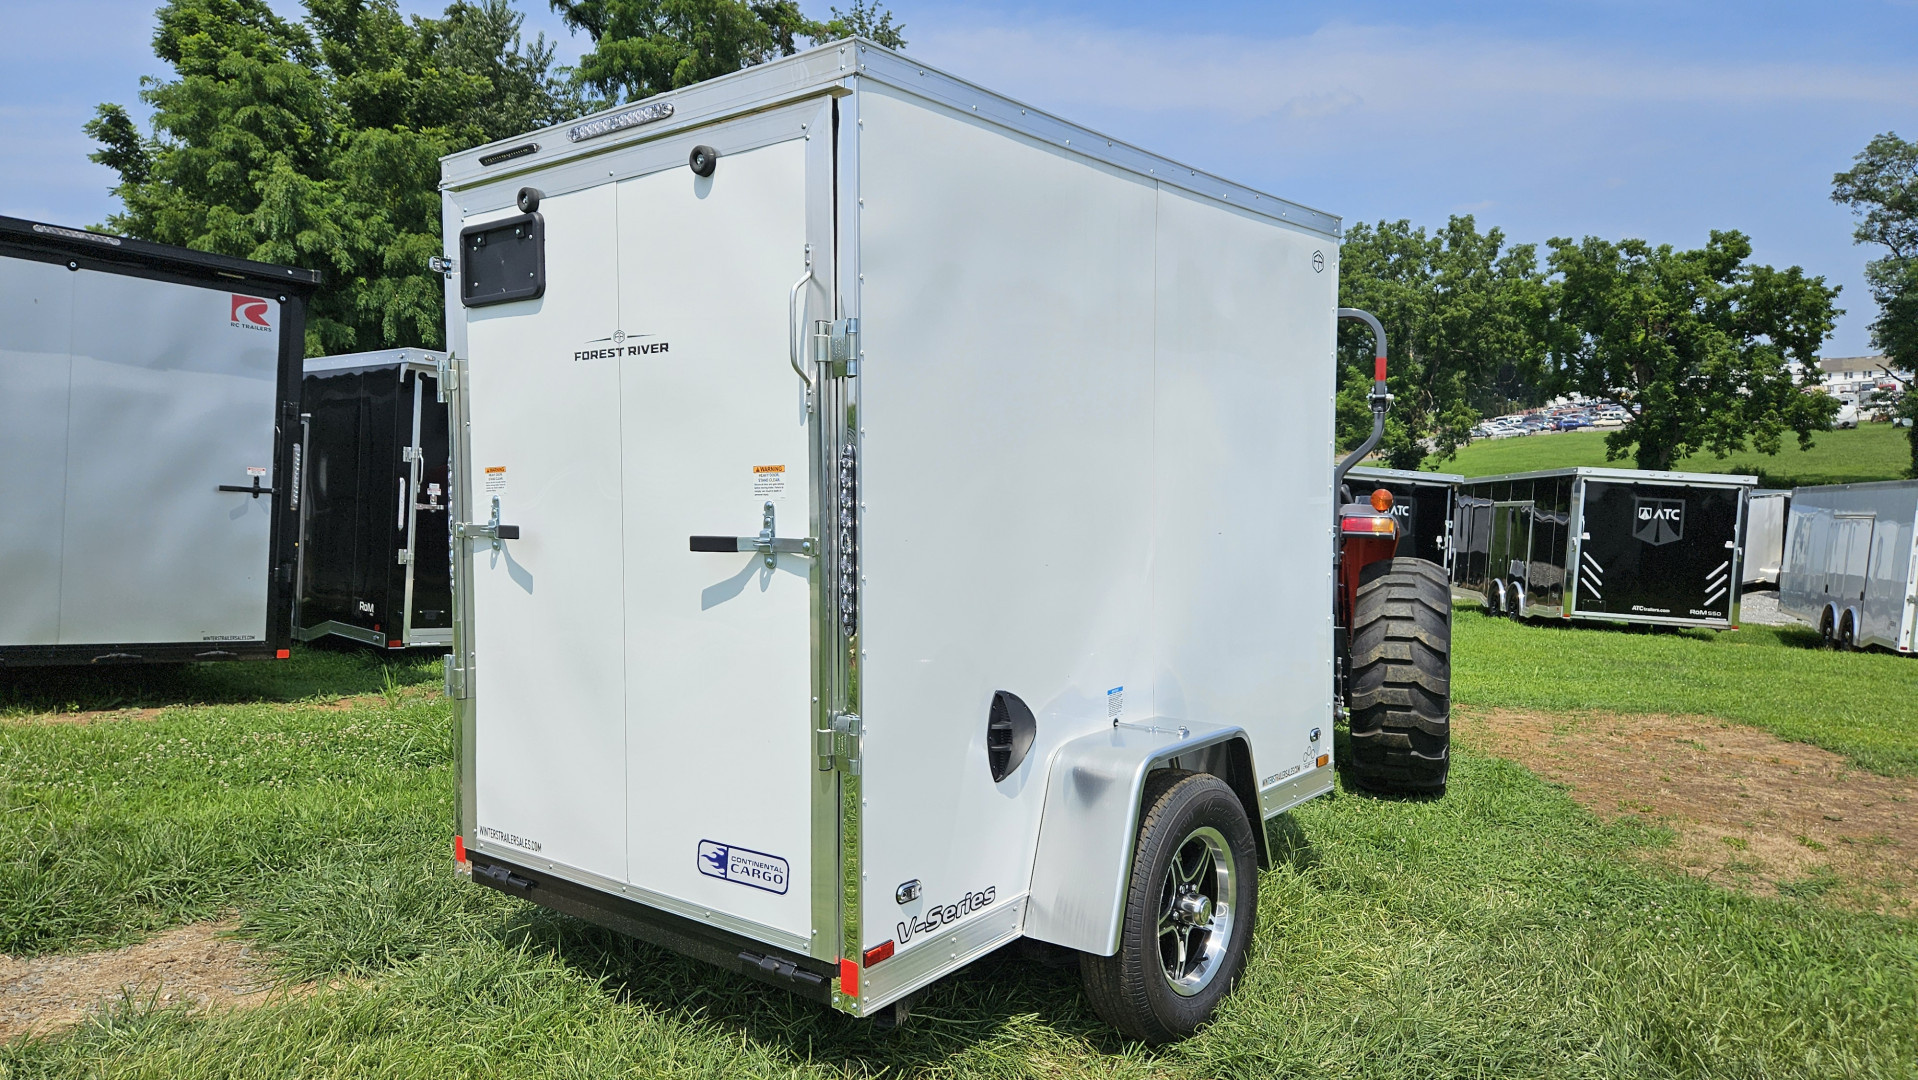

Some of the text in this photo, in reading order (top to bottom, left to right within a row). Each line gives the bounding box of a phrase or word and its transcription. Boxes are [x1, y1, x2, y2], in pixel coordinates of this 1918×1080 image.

[242, 323, 272, 332] TRAILERS
[574, 342, 669, 361] FOREST RIVER
[1390, 505, 1410, 516] ATC
[1653, 508, 1681, 521] ATC
[359, 600, 375, 613] RoM
[479, 825, 542, 852] WINTERSTRAILERSALES.COM
[730, 863, 784, 885] CARGO
[731, 855, 784, 874] CONTINENTAL
[896, 885, 996, 945] V-Series
